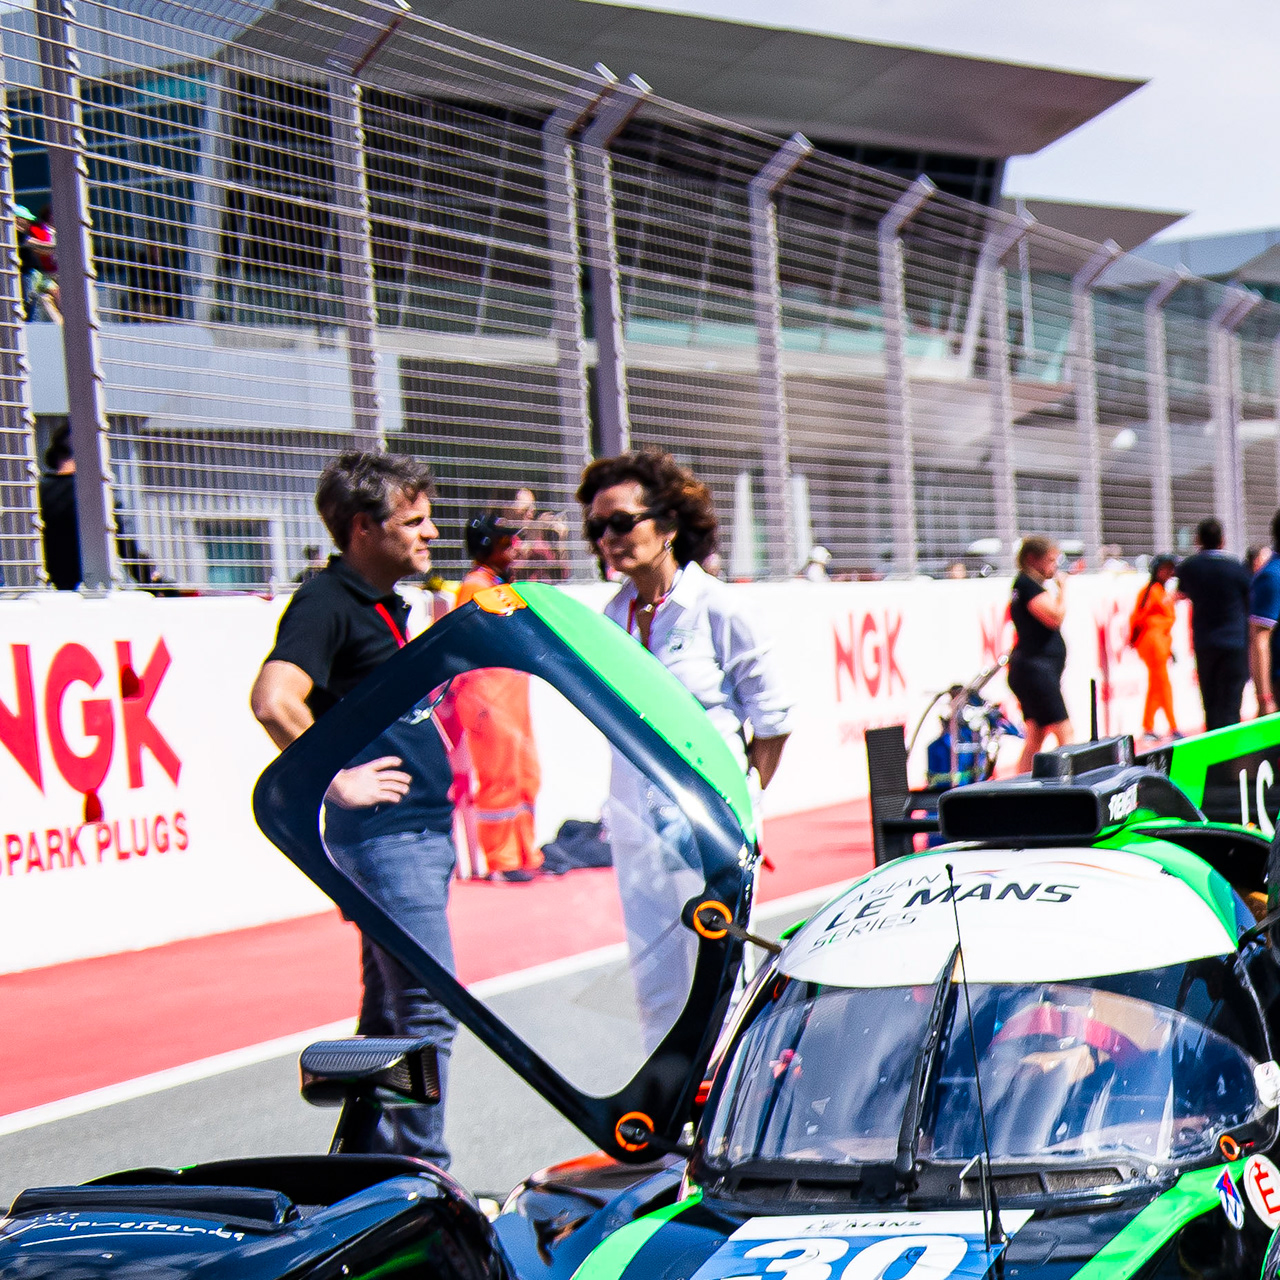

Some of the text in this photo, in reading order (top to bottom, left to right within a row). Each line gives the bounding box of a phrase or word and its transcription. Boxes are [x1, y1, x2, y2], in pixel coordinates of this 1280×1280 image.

[833, 609, 907, 703] NGK
[0, 810, 189, 877] PARK PLUGS
[824, 881, 1081, 931] LE MANS
[846, 872, 943, 906] ASIAN
[808, 910, 922, 954] SERIES
